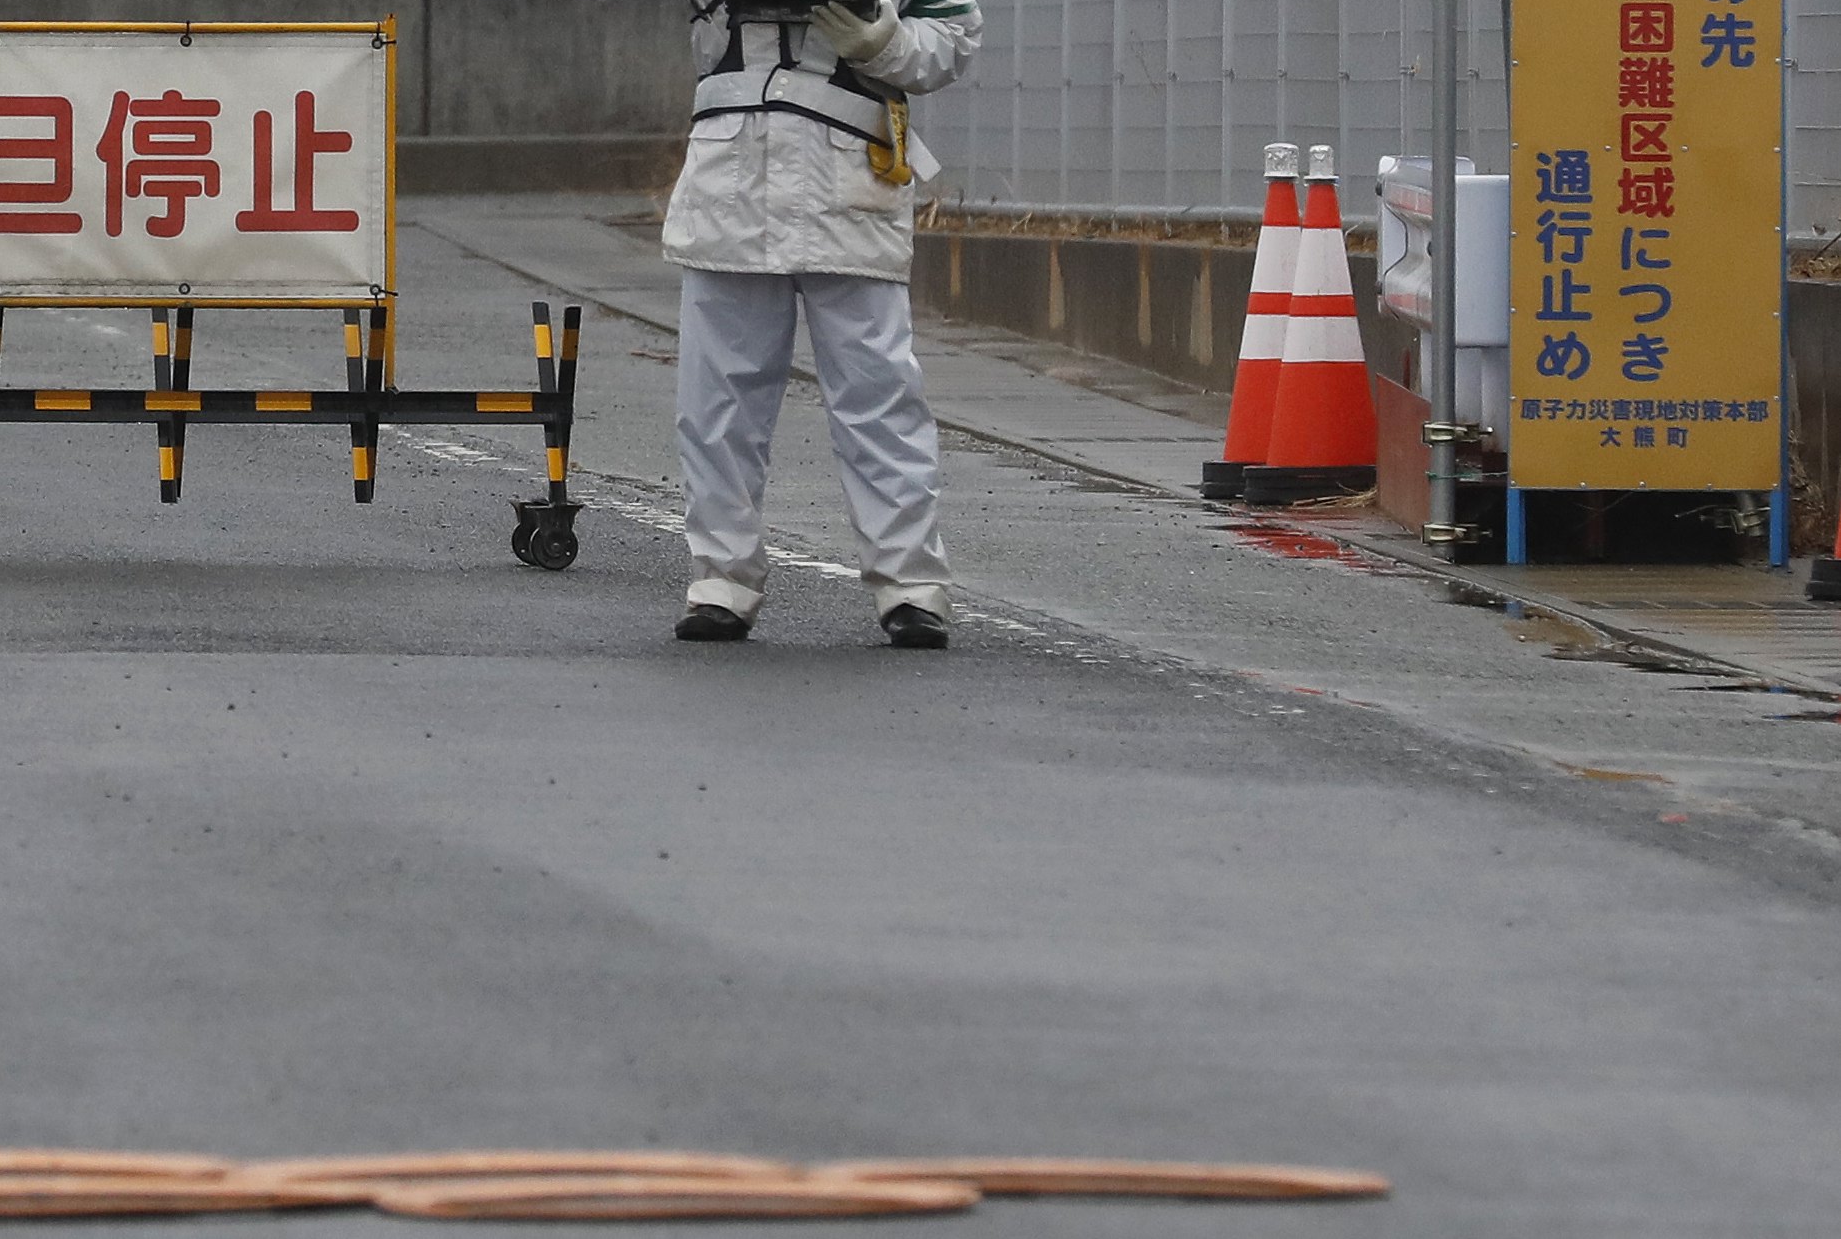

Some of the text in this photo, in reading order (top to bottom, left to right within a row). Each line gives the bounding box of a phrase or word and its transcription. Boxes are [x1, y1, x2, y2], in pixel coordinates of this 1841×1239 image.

[1536, 149, 1593, 380] 通行止め
[1521, 398, 1769, 422] 原子力災害現地対策本部
[1600, 426, 1689, 449] 大熊町
